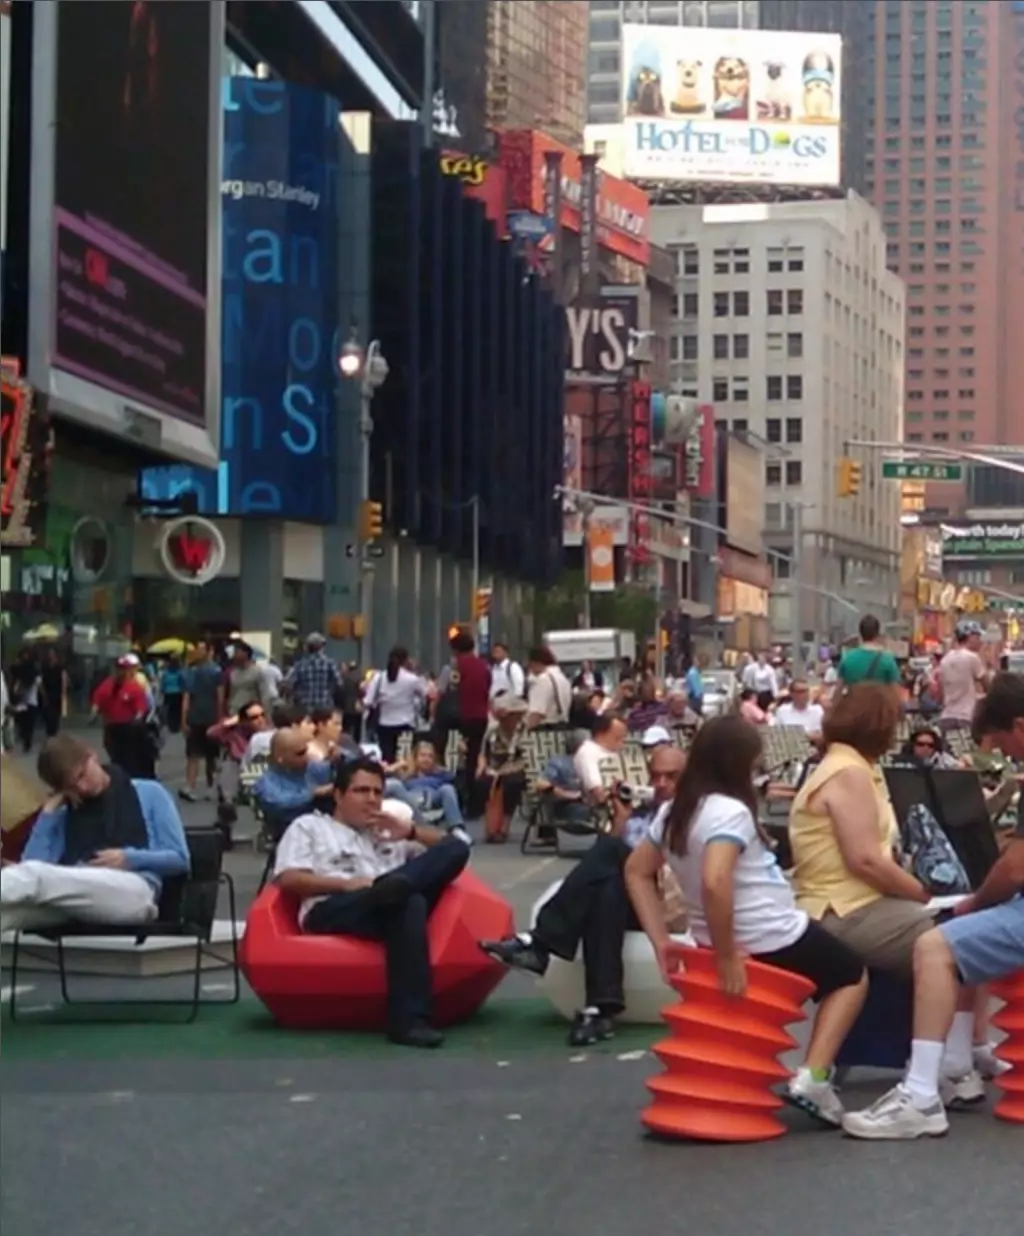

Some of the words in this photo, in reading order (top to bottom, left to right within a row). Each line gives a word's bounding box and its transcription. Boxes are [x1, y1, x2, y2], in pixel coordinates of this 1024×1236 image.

[636, 119, 728, 154] HOTEL
[266, 179, 321, 211] Stanley
[911, 467, 928, 477] 47
